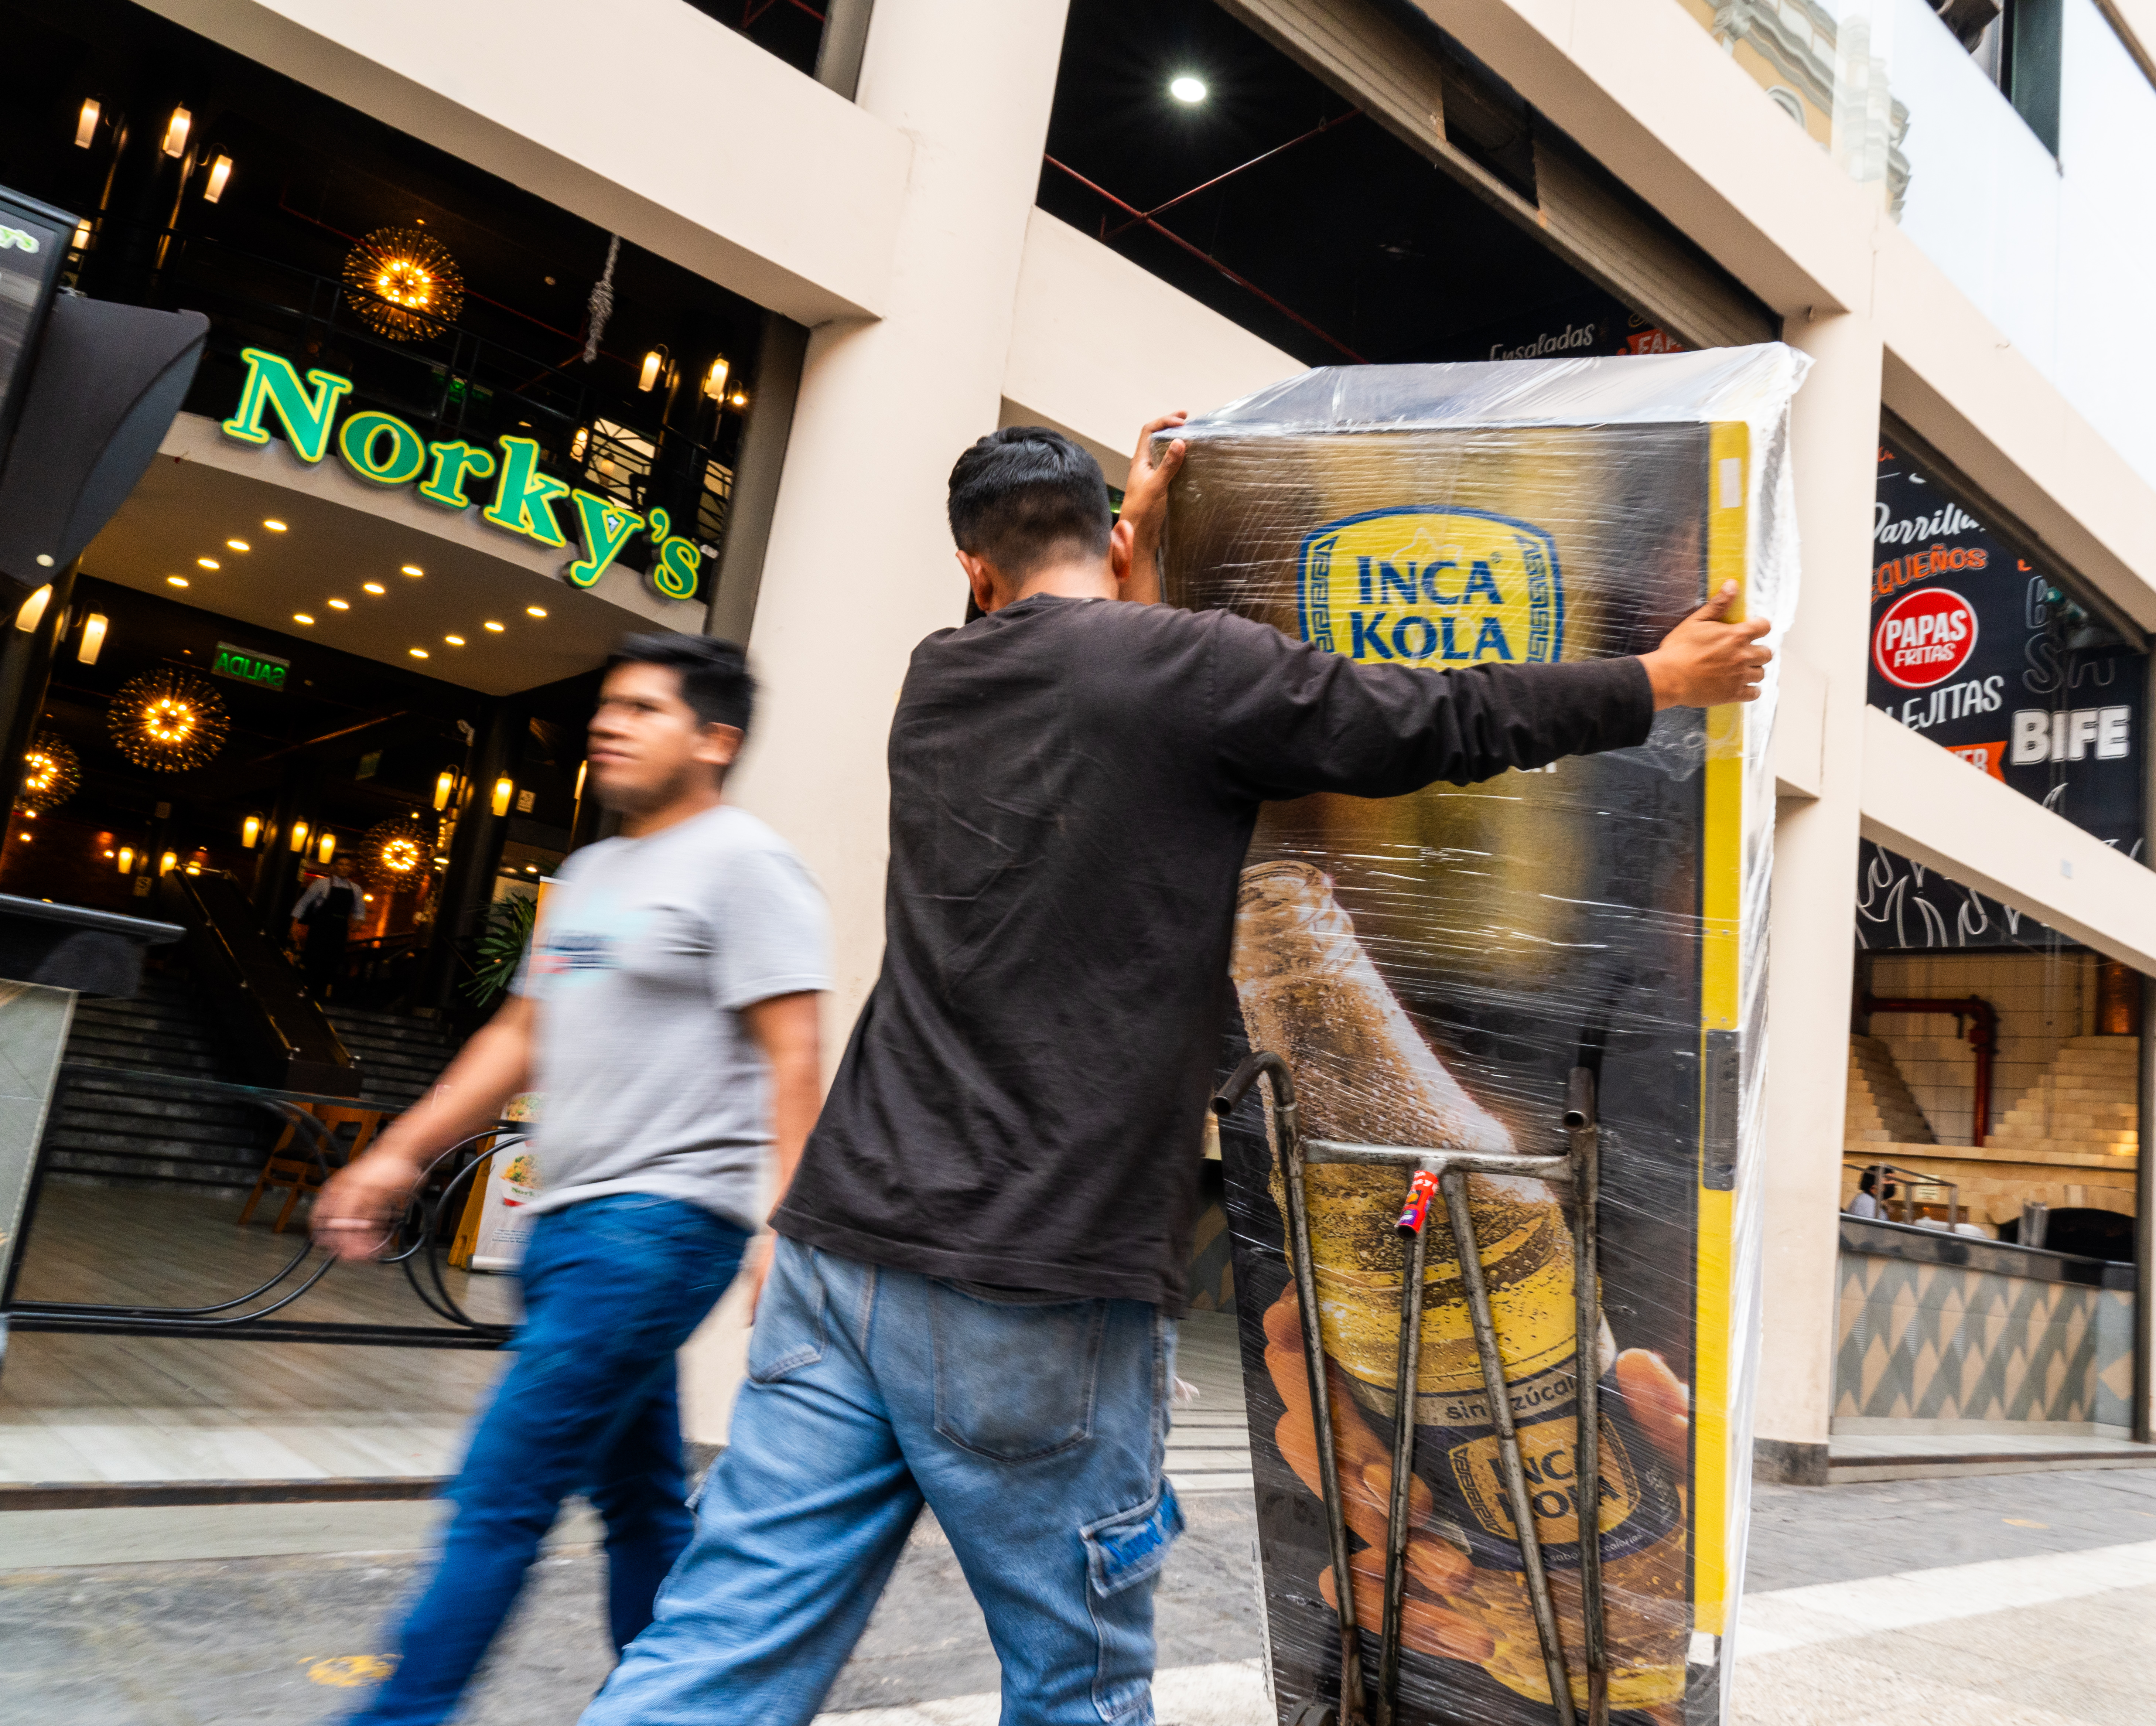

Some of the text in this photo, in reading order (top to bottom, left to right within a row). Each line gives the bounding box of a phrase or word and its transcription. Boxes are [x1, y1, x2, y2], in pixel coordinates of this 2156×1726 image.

[1489, 323, 1595, 361] Ensaladas
[222, 348, 703, 600] Norky's
[1356, 555, 1505, 605] INCA
[1349, 611, 1514, 661] KOLA
[1885, 610, 1968, 651] PAPAS
[1893, 643, 1956, 668] FRITAS
[1886, 675, 2005, 731] EJITAS
[2009, 706, 2132, 766] BIFE
[1446, 1376, 1576, 1420] sin zúcar
